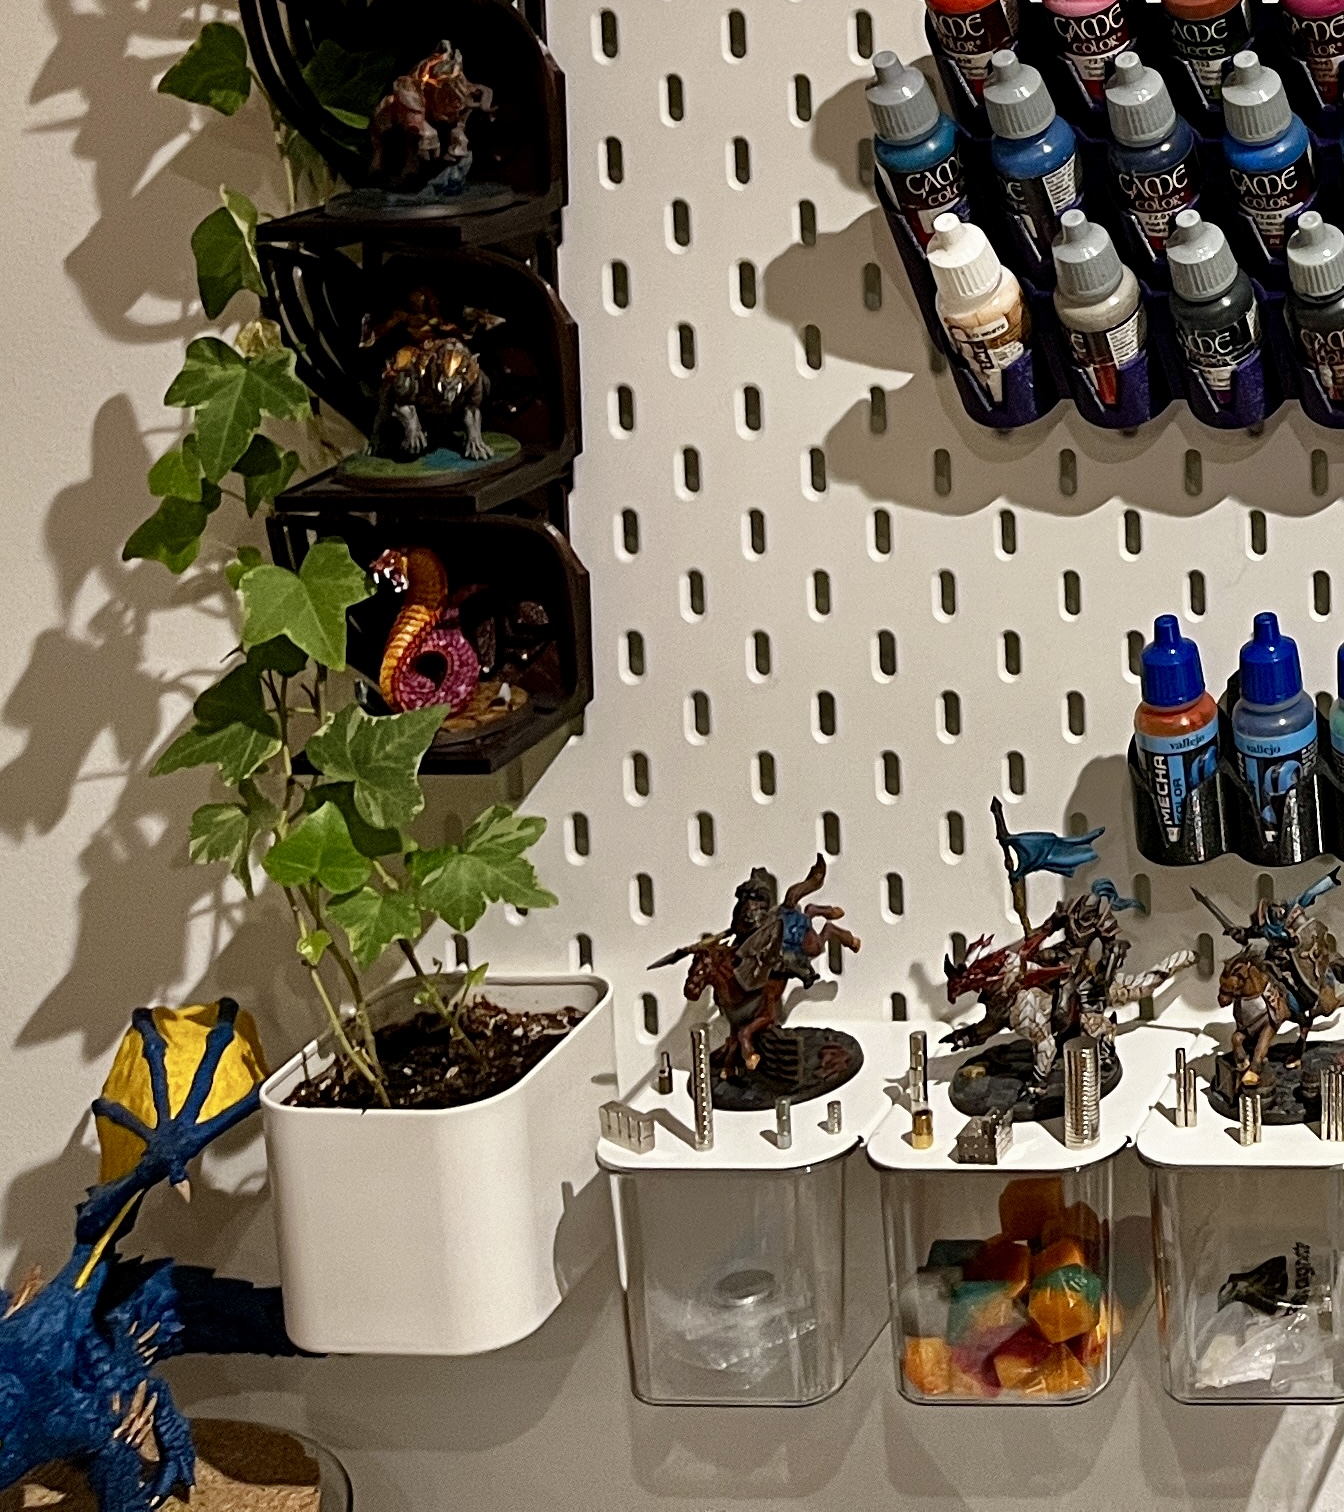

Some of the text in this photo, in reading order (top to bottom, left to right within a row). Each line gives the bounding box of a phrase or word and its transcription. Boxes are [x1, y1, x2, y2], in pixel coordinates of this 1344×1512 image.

[935, 13, 985, 38] AME
[1054, 4, 1124, 39] GAME
[1172, 18, 1228, 42] AME
[942, 37, 978, 53] OLOR
[1073, 32, 1118, 54] COLOR
[1118, 164, 1188, 200] GAME
[1230, 166, 1297, 196] GAME
[1136, 196, 1182, 211] COLOR
[1245, 196, 1290, 209] COLOR
[1155, 755, 1172, 826] MECHA
